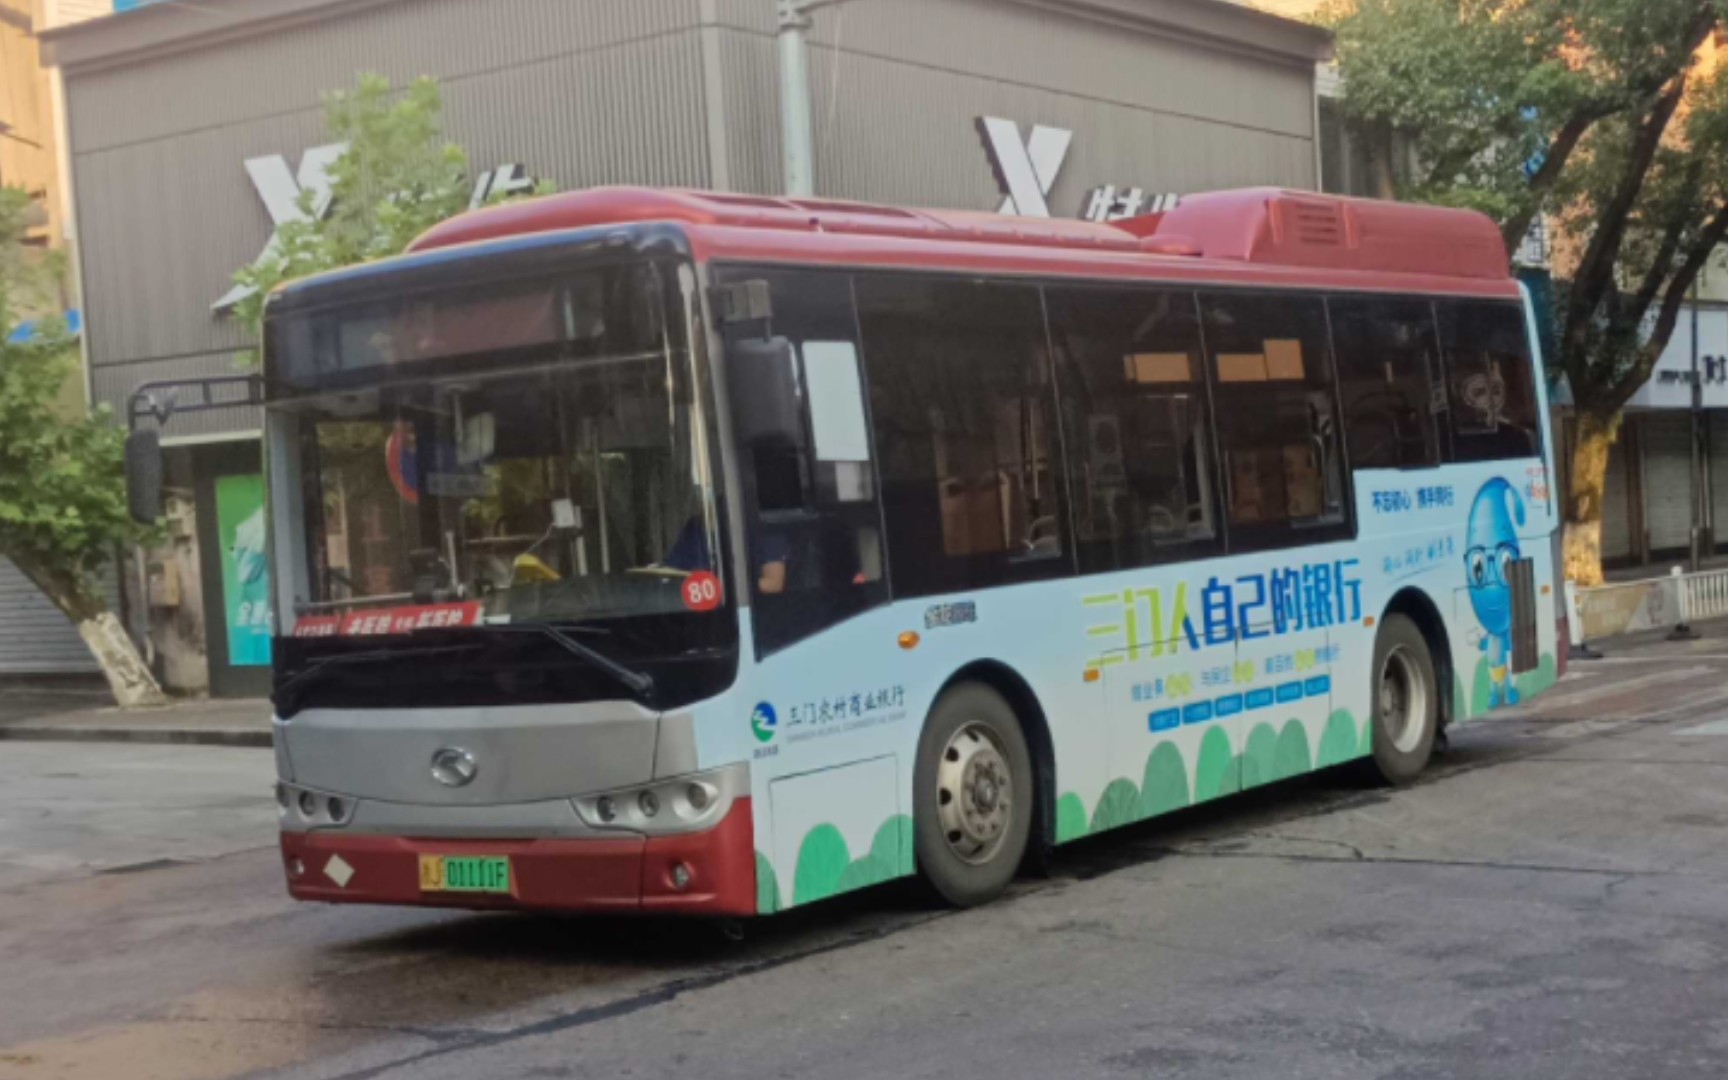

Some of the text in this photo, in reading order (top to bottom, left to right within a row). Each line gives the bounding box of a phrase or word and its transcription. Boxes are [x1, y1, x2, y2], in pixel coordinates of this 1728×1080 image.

[688, 578, 716, 603] 80
[1082, 558, 1363, 668] 三门人自己的银行
